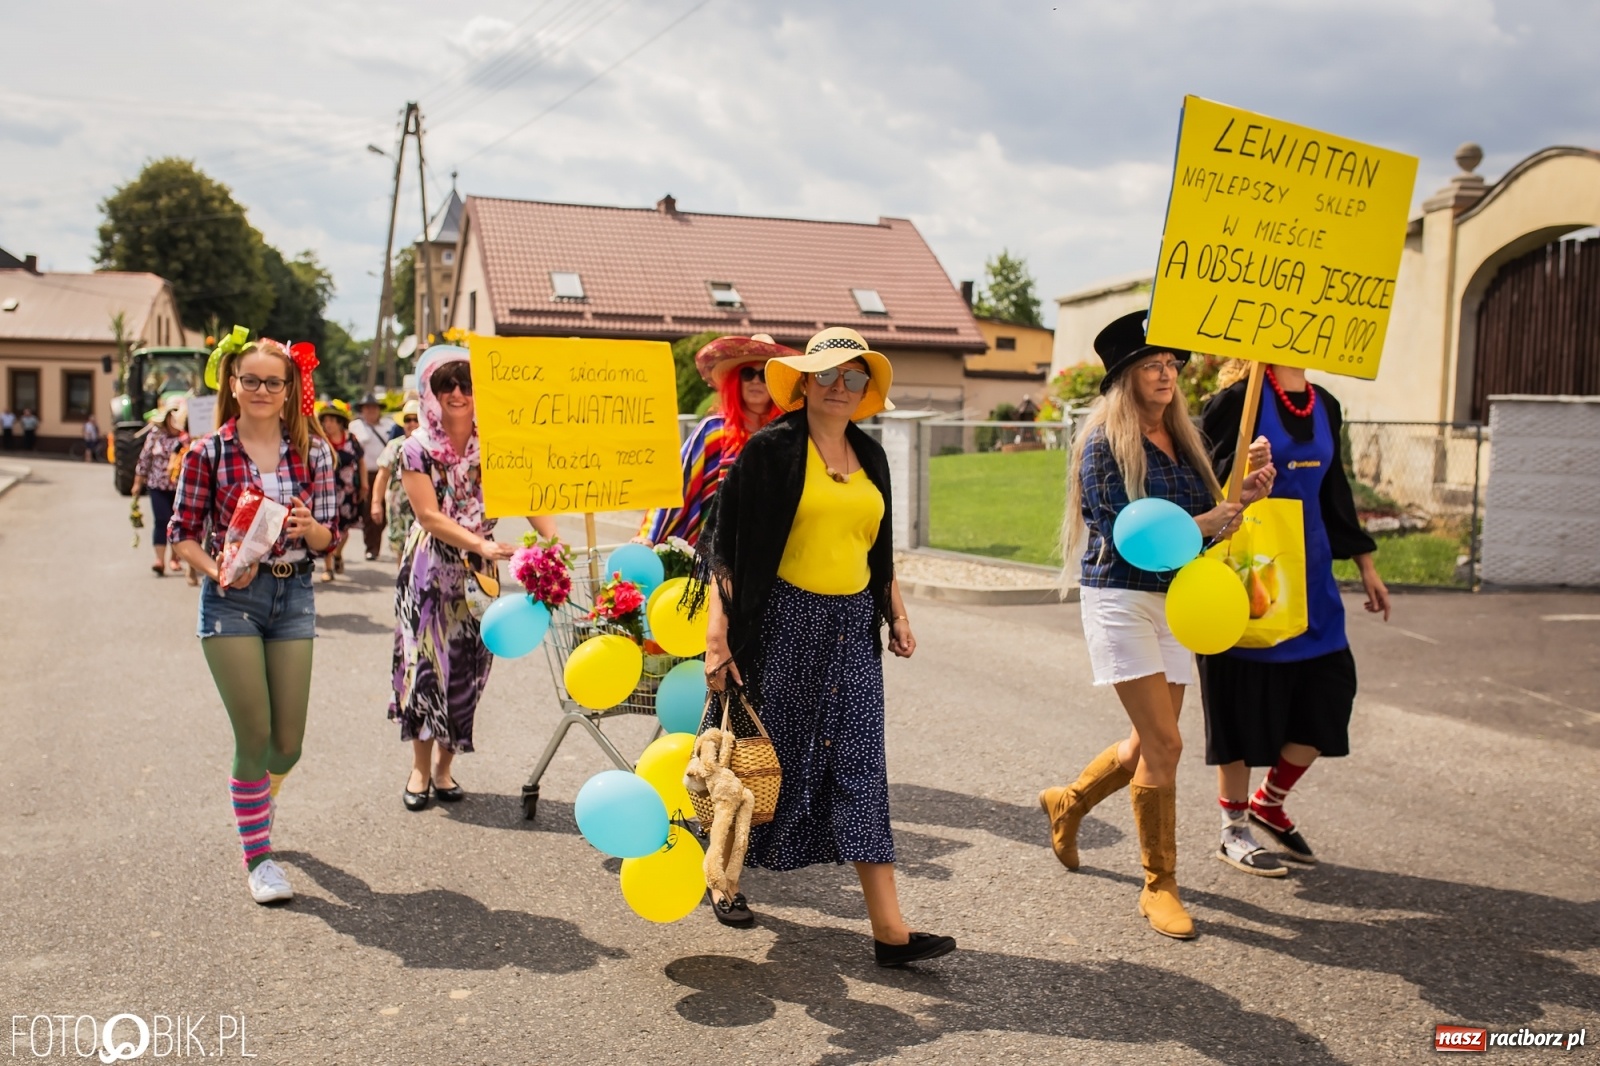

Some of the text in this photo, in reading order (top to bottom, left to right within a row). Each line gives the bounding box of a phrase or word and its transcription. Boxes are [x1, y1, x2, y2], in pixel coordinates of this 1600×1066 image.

[1213, 117, 1380, 189] LEWIATAN
[1182, 165, 1367, 218] NAJLEPSZY SKLEP
[1222, 214, 1327, 250] W MIEŚCIE
[1164, 239, 1396, 309] A OBSŁUGA JESZCZE
[487, 350, 648, 383] Rzecz wiadoma
[507, 407, 525, 425] w
[486, 442, 656, 482] każdy każdą rzecz
[529, 479, 633, 512] DOSTANIE
